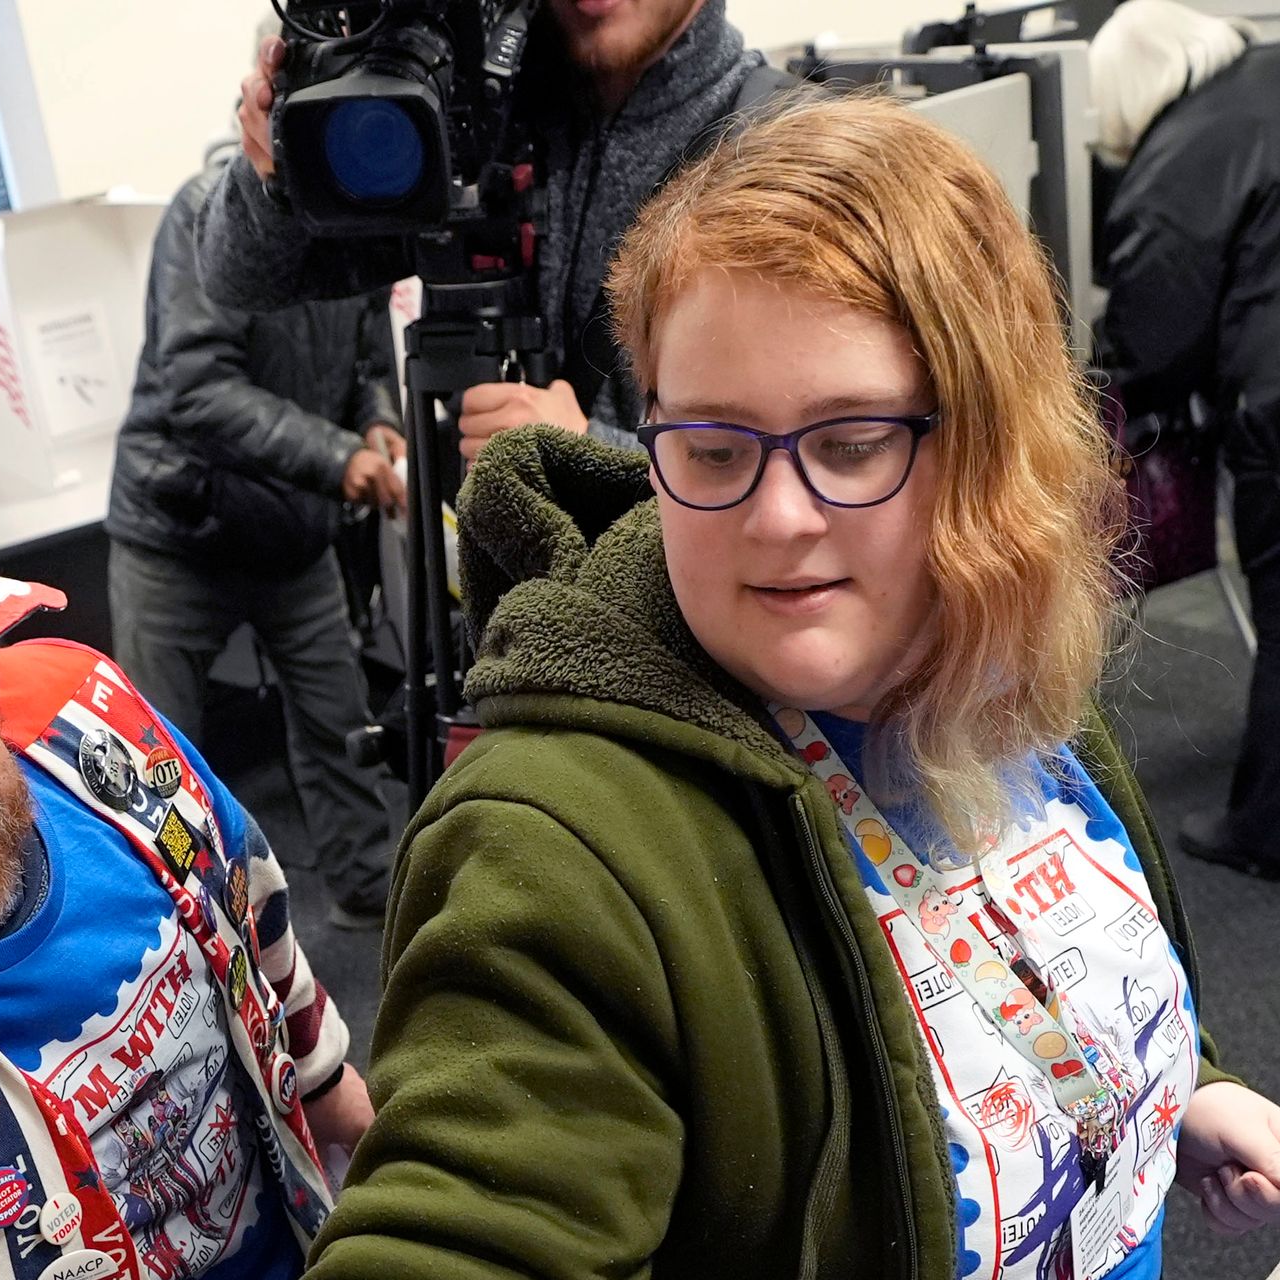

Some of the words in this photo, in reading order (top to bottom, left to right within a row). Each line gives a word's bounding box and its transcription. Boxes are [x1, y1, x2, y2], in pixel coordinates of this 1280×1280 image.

[150, 760, 180, 788] VOTE
[1115, 908, 1154, 941] VOTE
[110, 949, 193, 1075] WITH
[174, 991, 195, 1029] VOTE!
[1161, 1013, 1185, 1044] VOTE
[12, 1182, 19, 1190] A
[46, 1202, 77, 1233] VOTED
[52, 1200, 61, 1210] I
[51, 1212, 82, 1244] TODAY
